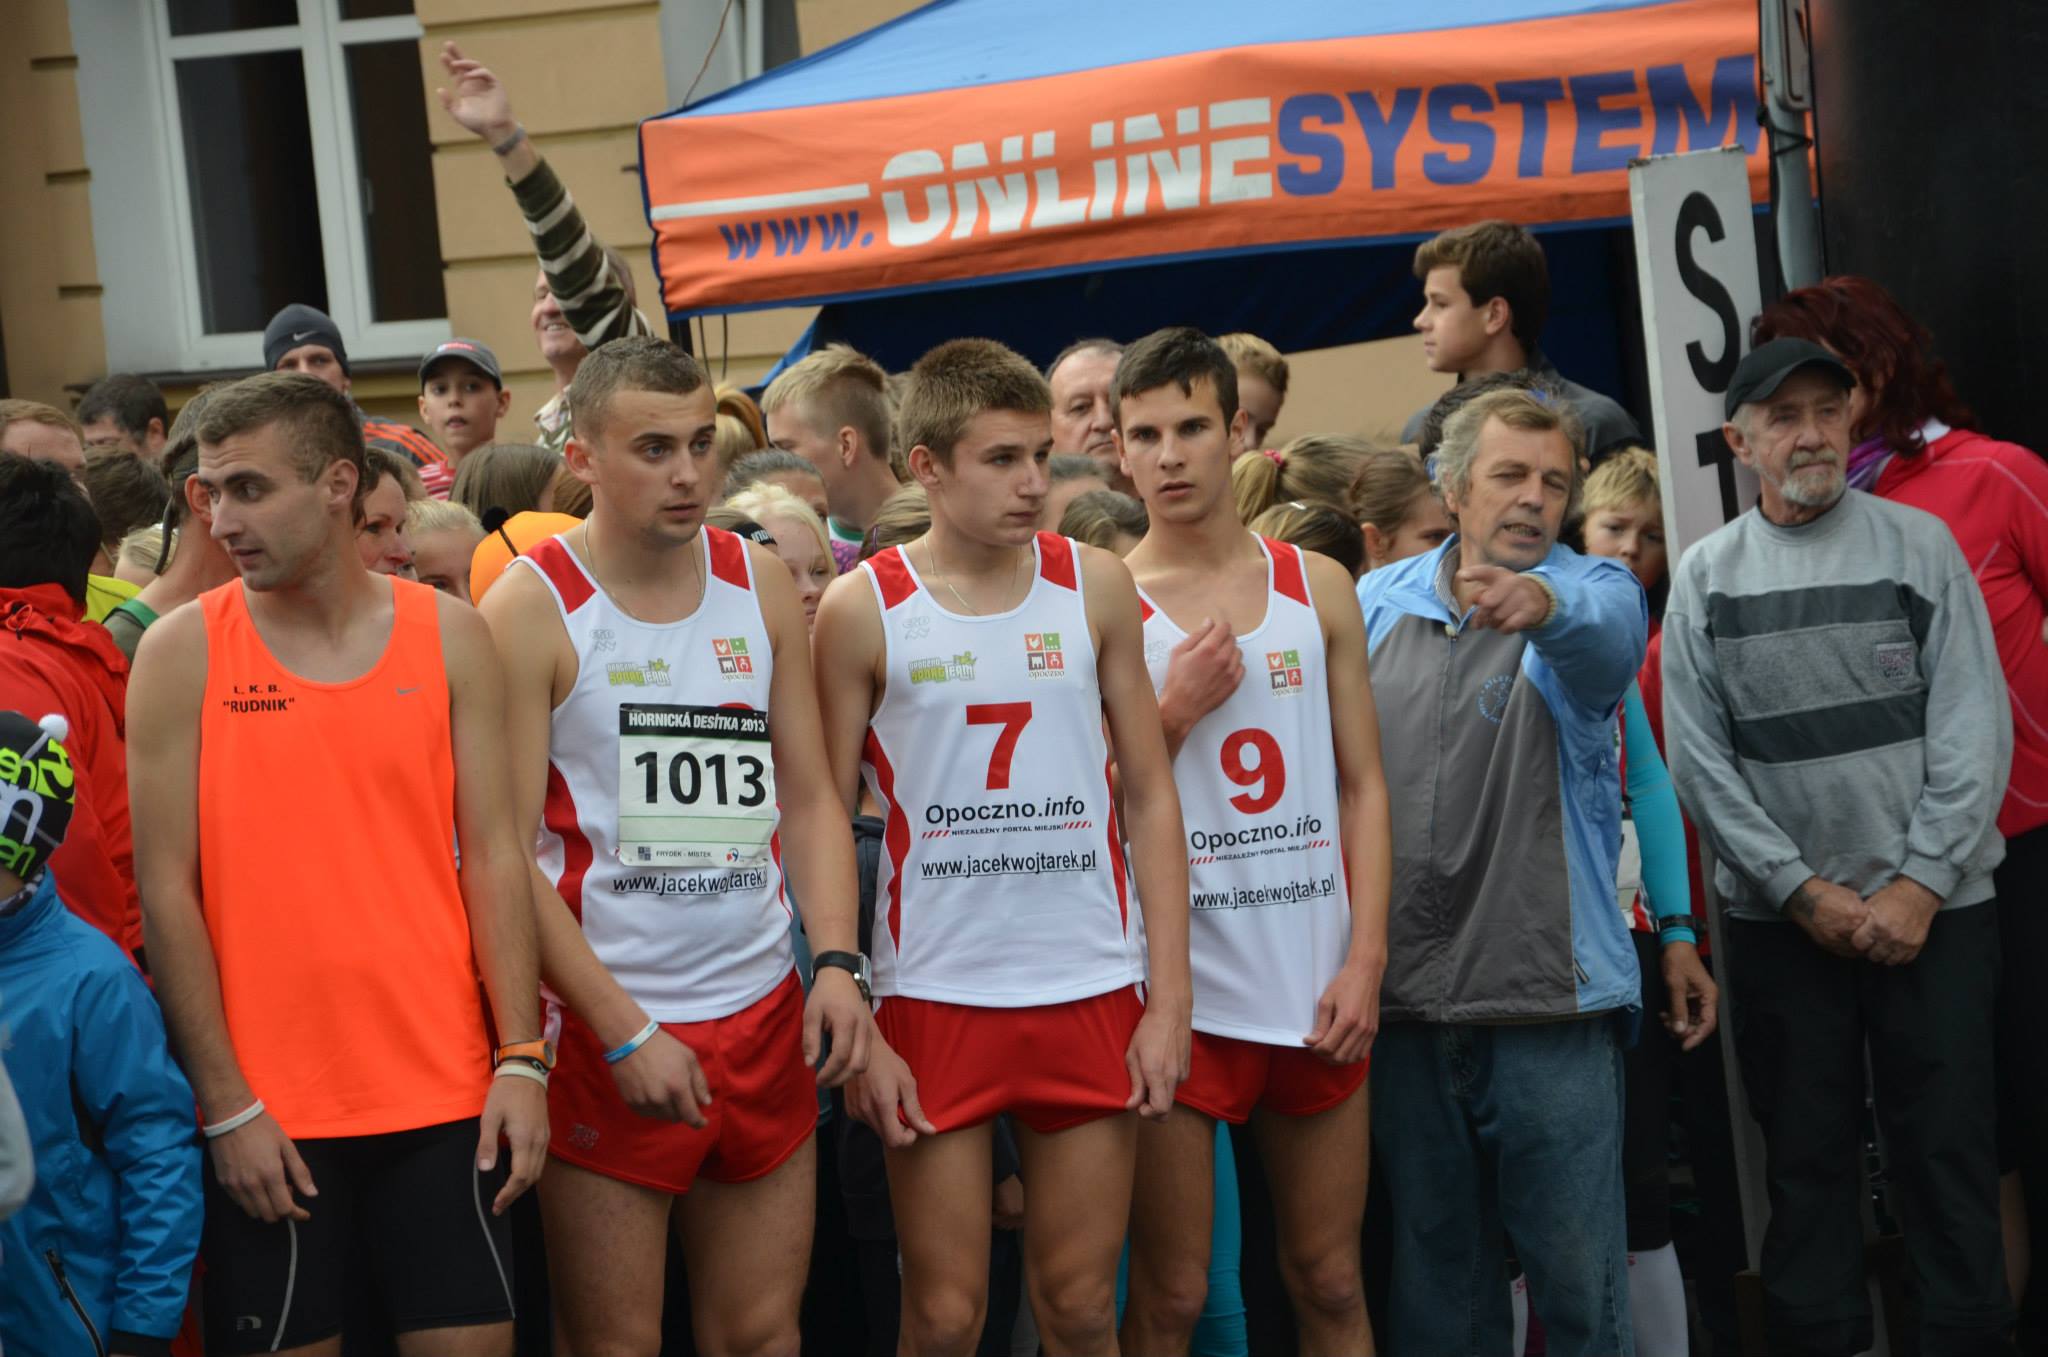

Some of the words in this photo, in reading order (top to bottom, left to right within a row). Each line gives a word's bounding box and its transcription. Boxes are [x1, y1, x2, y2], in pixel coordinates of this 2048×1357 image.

[629, 711, 691, 728] HORNICKÁ
[693, 713, 739, 731] DESÍTKA
[740, 718, 766, 733] 2013
[966, 702, 1032, 790] 7
[634, 751, 766, 807] 1013
[1220, 728, 1286, 815] 9
[925, 796, 1085, 828] Opoczno.info
[1003, 825, 1032, 833] PORTAL
[922, 850, 1096, 879] www.jacekwojtarek.pl
